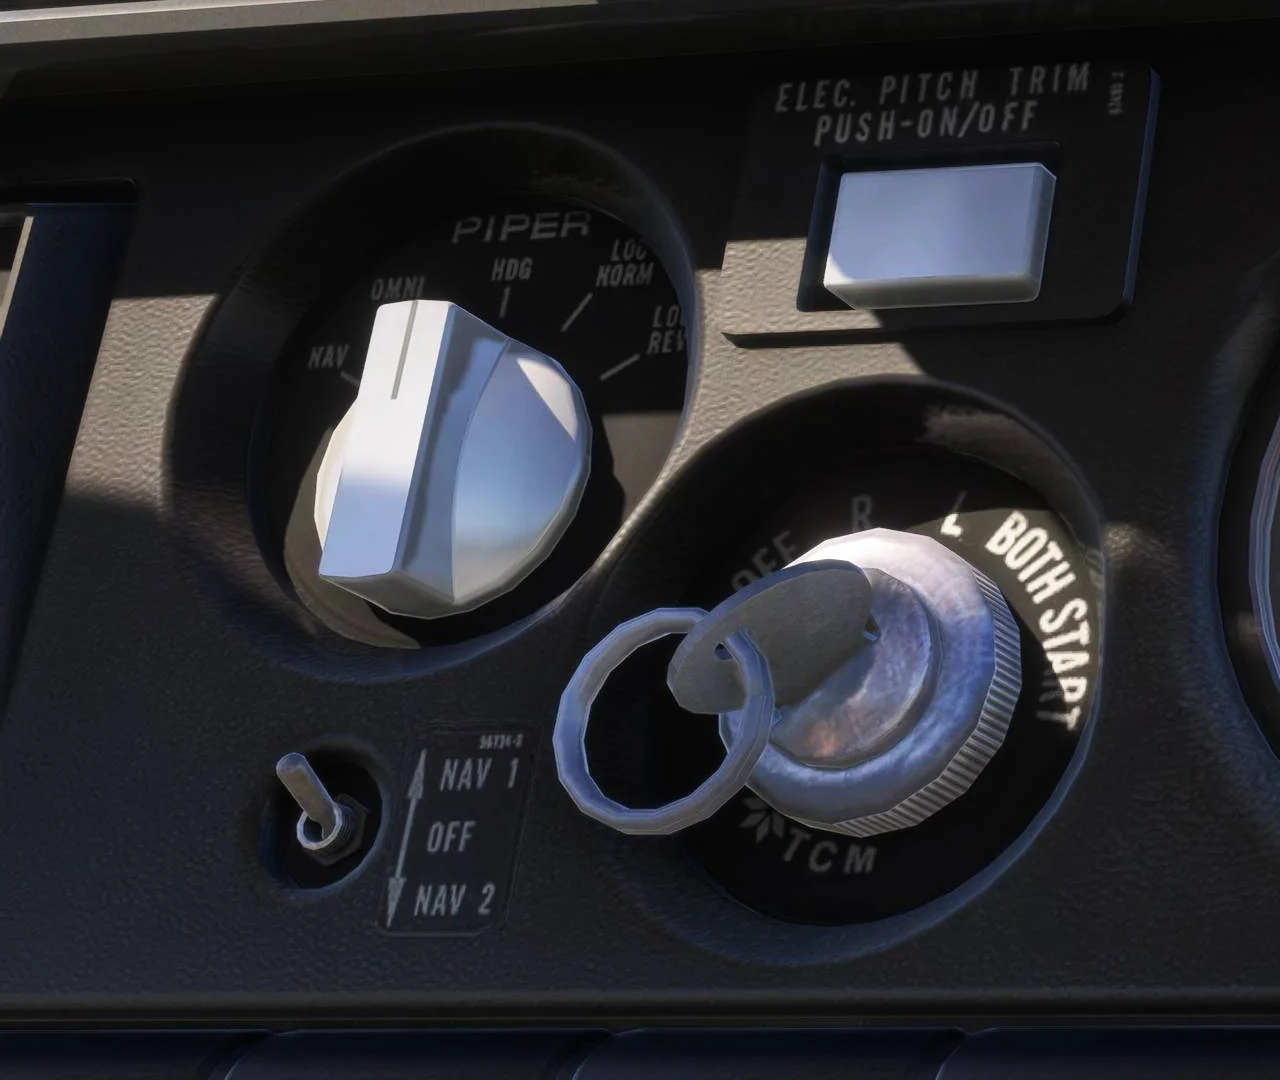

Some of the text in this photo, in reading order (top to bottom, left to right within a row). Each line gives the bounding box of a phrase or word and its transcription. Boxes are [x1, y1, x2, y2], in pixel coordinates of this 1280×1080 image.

[775, 78, 857, 113] ELEC.
[879, 68, 979, 106] PITCH
[1008, 61, 1092, 97] TRIM
[813, 100, 1040, 148] PUSH-ON/OFF
[452, 210, 592, 245] PIPER
[491, 257, 534, 282] HDG
[596, 261, 654, 288] NORM
[371, 275, 427, 301] OMNI
[308, 343, 350, 371] NAV
[984, 508, 1077, 605] BOTH
[1037, 597, 1093, 731] START
[439, 758, 520, 792] NAV 1
[427, 821, 476, 854] OFF
[414, 882, 496, 917] NAV 2
